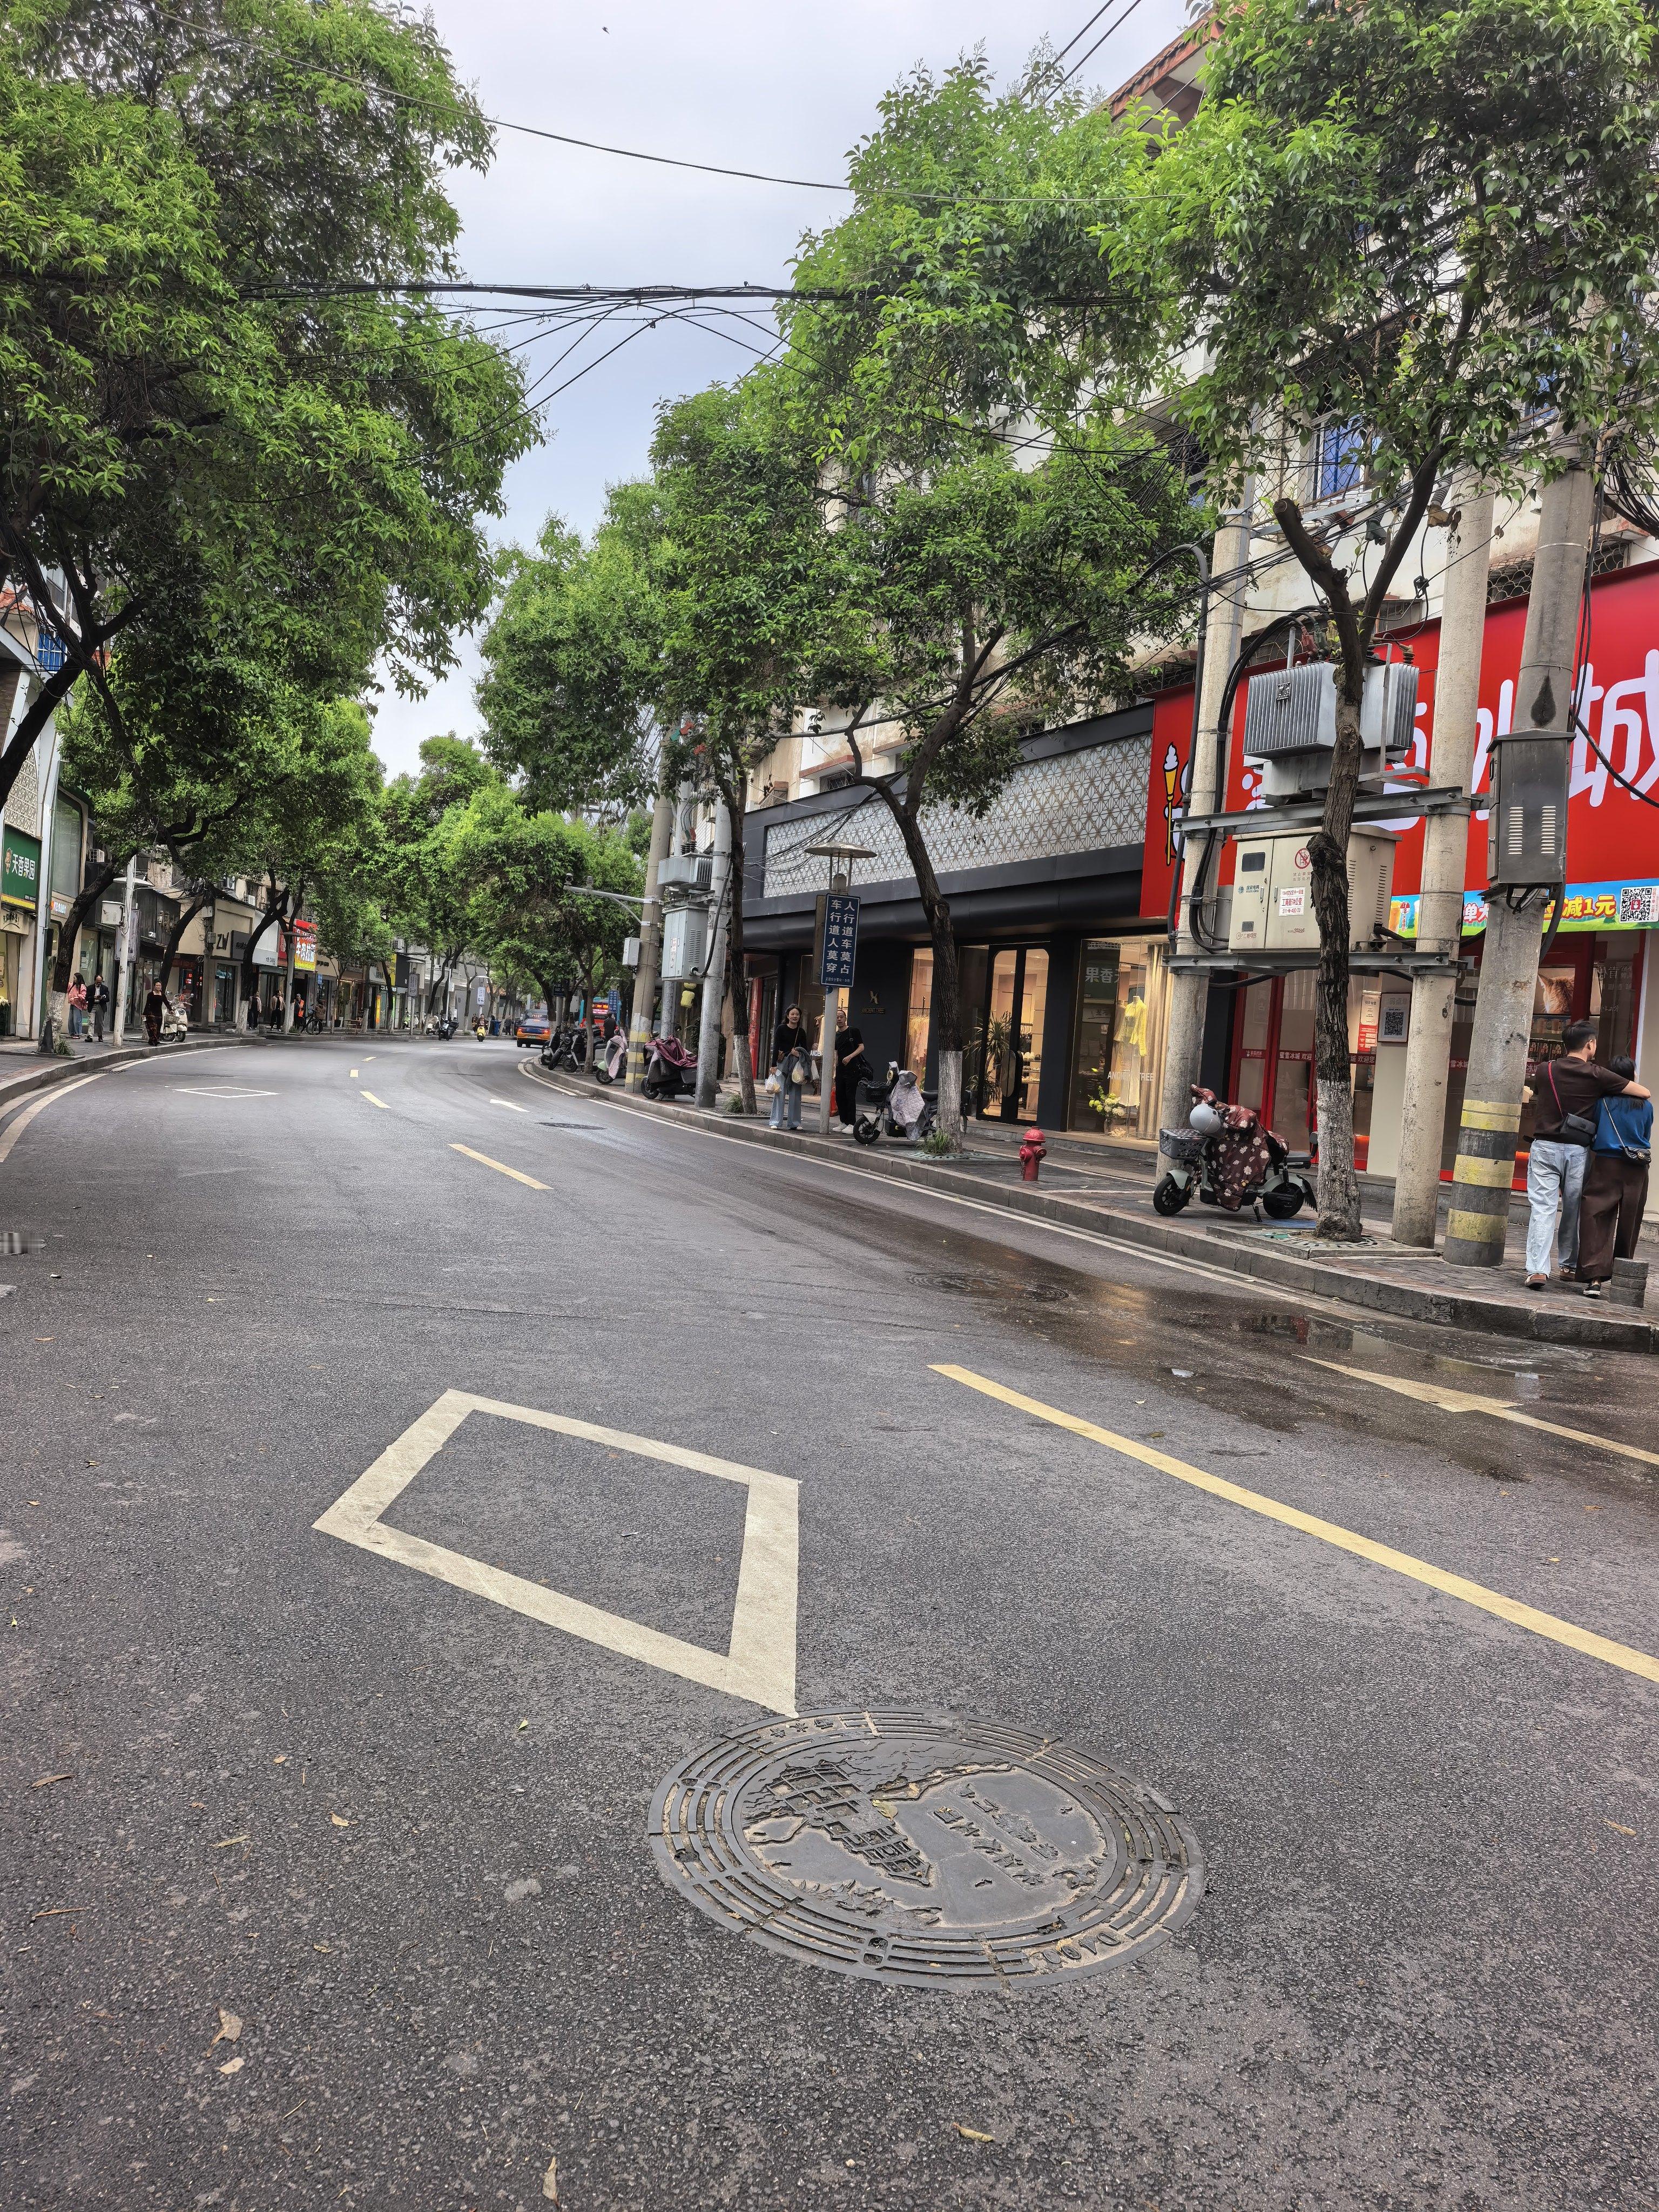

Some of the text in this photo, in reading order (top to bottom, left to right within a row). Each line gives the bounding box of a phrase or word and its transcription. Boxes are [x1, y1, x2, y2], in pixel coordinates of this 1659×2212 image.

[12, 854, 36, 880] 天香果园
[826, 900, 842, 973] 车行道人莫穿
[840, 901, 855, 974] 人行道车莫占
